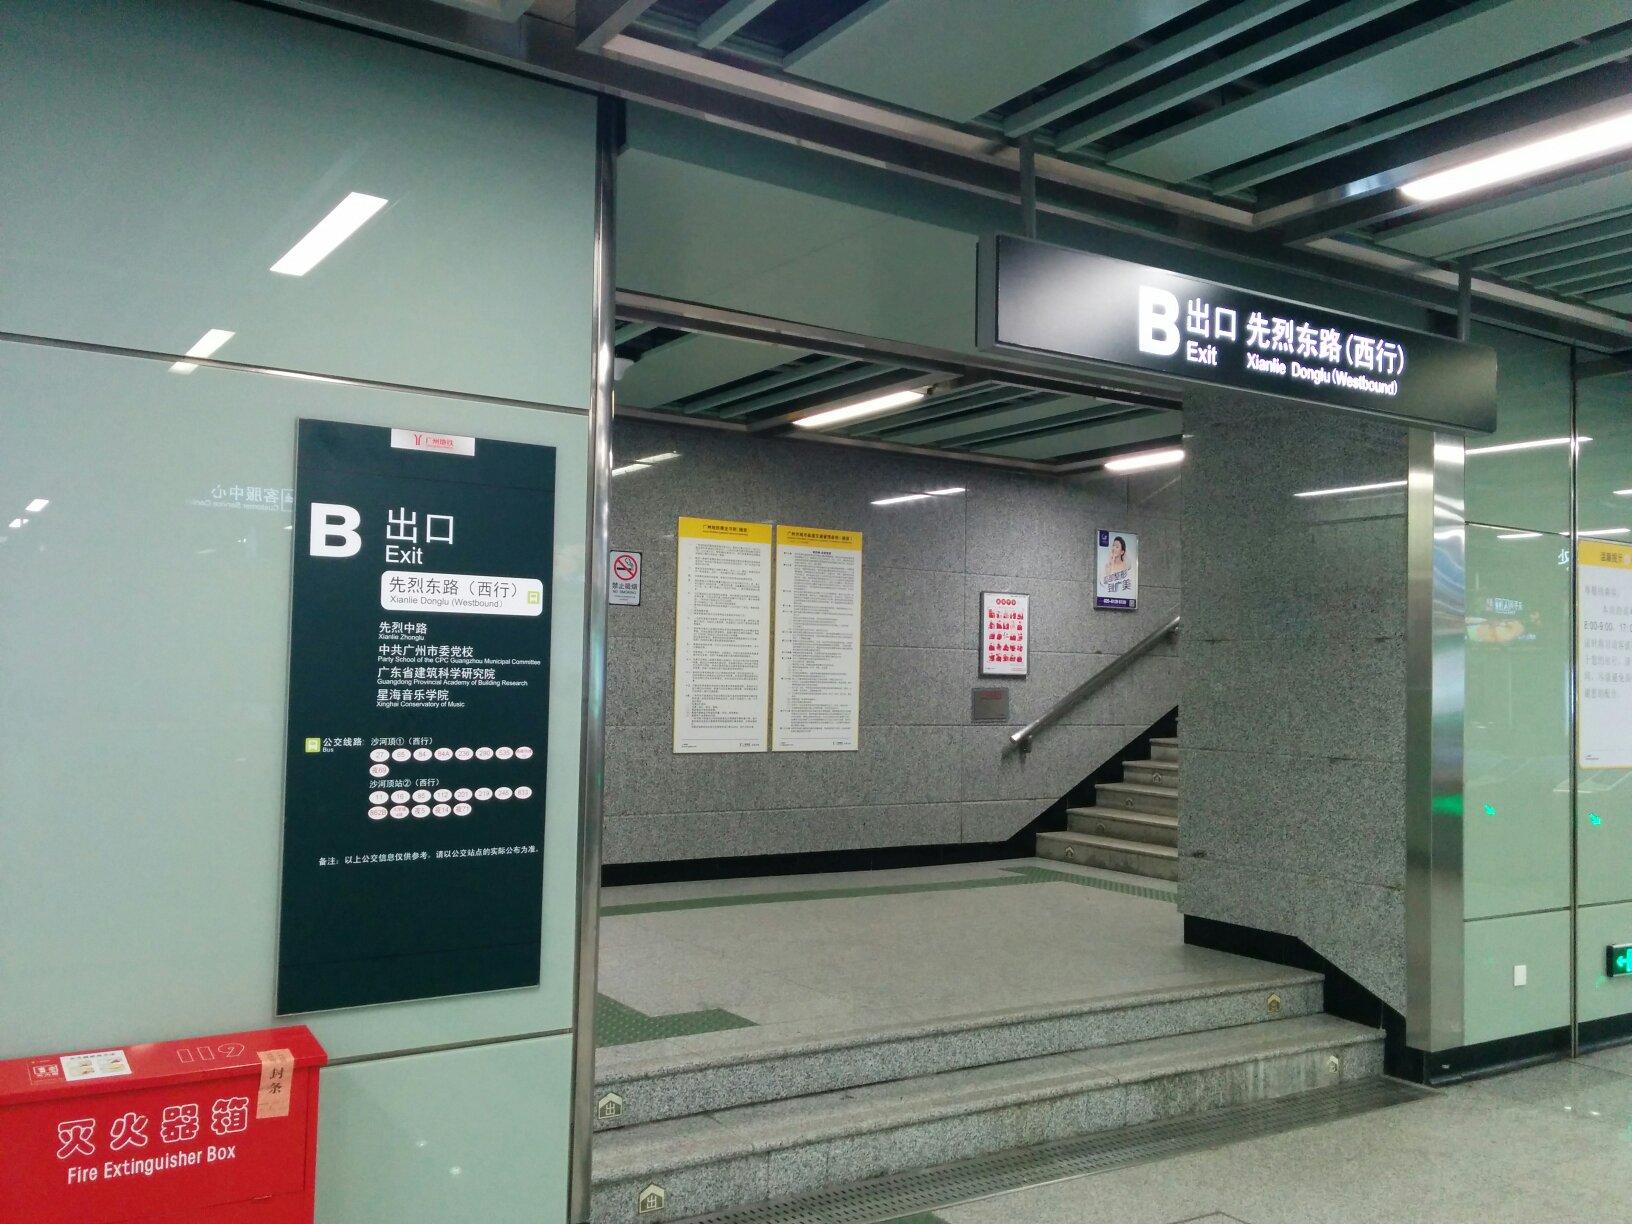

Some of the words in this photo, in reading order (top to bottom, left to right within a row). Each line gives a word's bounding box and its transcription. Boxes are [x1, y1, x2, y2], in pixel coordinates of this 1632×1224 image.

[1138, 284, 1181, 356] B
[1186, 297, 1237, 342] 出口
[1186, 340, 1218, 366] Exit
[1246, 351, 1287, 375] Xianlie
[1291, 361, 1331, 385] Donglu
[309, 502, 362, 558] B
[386, 507, 454, 545] 出口
[385, 545, 423, 565] Exit
[390, 595, 419, 605] Xianlie
[420, 596, 449, 607] Donglu
[378, 621, 428, 634] 先烈中路
[378, 644, 474, 658] 中共广州市委党校
[484, 658, 511, 666] Municipal
[377, 666, 496, 680] 广东省建筑科学研究院
[443, 679, 470, 687] Academy
[376, 688, 450, 701] 星海音乐学院
[176, 1042, 245, 1064] 119
[56, 1096, 249, 1160] 灭火器箱
[67, 1165, 98, 1185] Fire
[104, 1149, 202, 1180] Extinguisher
[207, 1144, 236, 1163] Box
